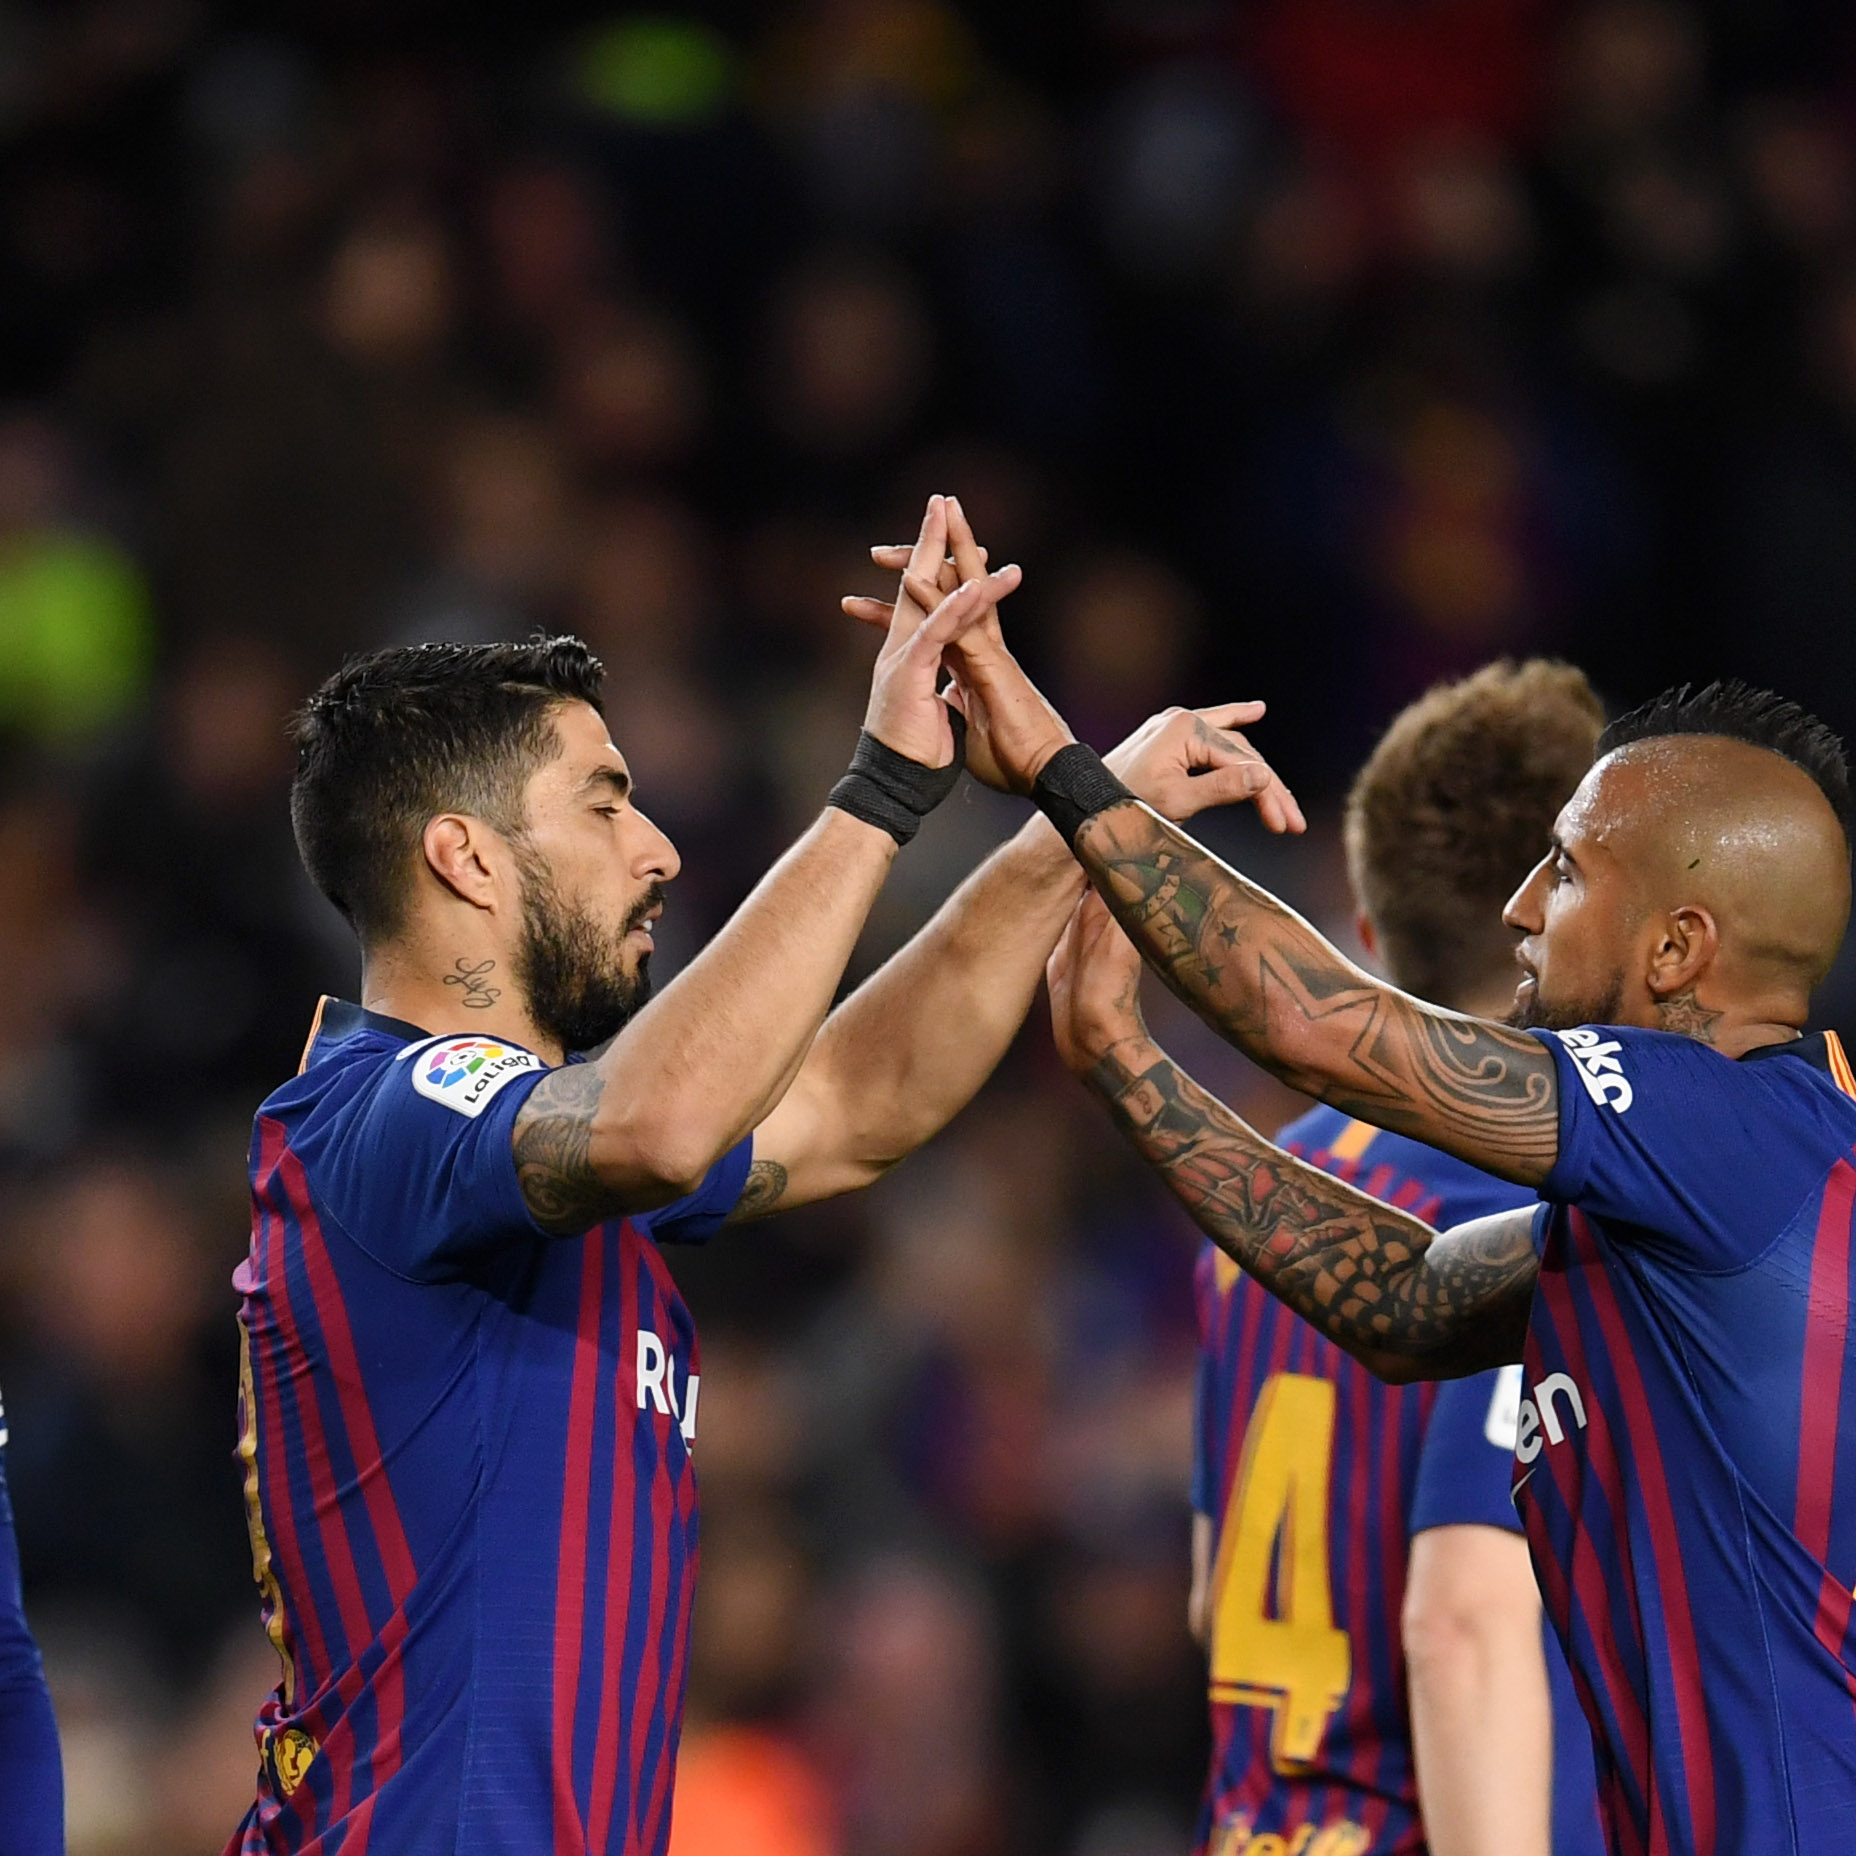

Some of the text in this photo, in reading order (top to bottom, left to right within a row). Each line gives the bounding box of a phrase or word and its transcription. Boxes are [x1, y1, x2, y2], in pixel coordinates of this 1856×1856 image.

[464, 1055, 532, 1104] LaLiga
[1515, 1372, 1588, 1464] en
[1208, 1372, 1352, 1776] 4
